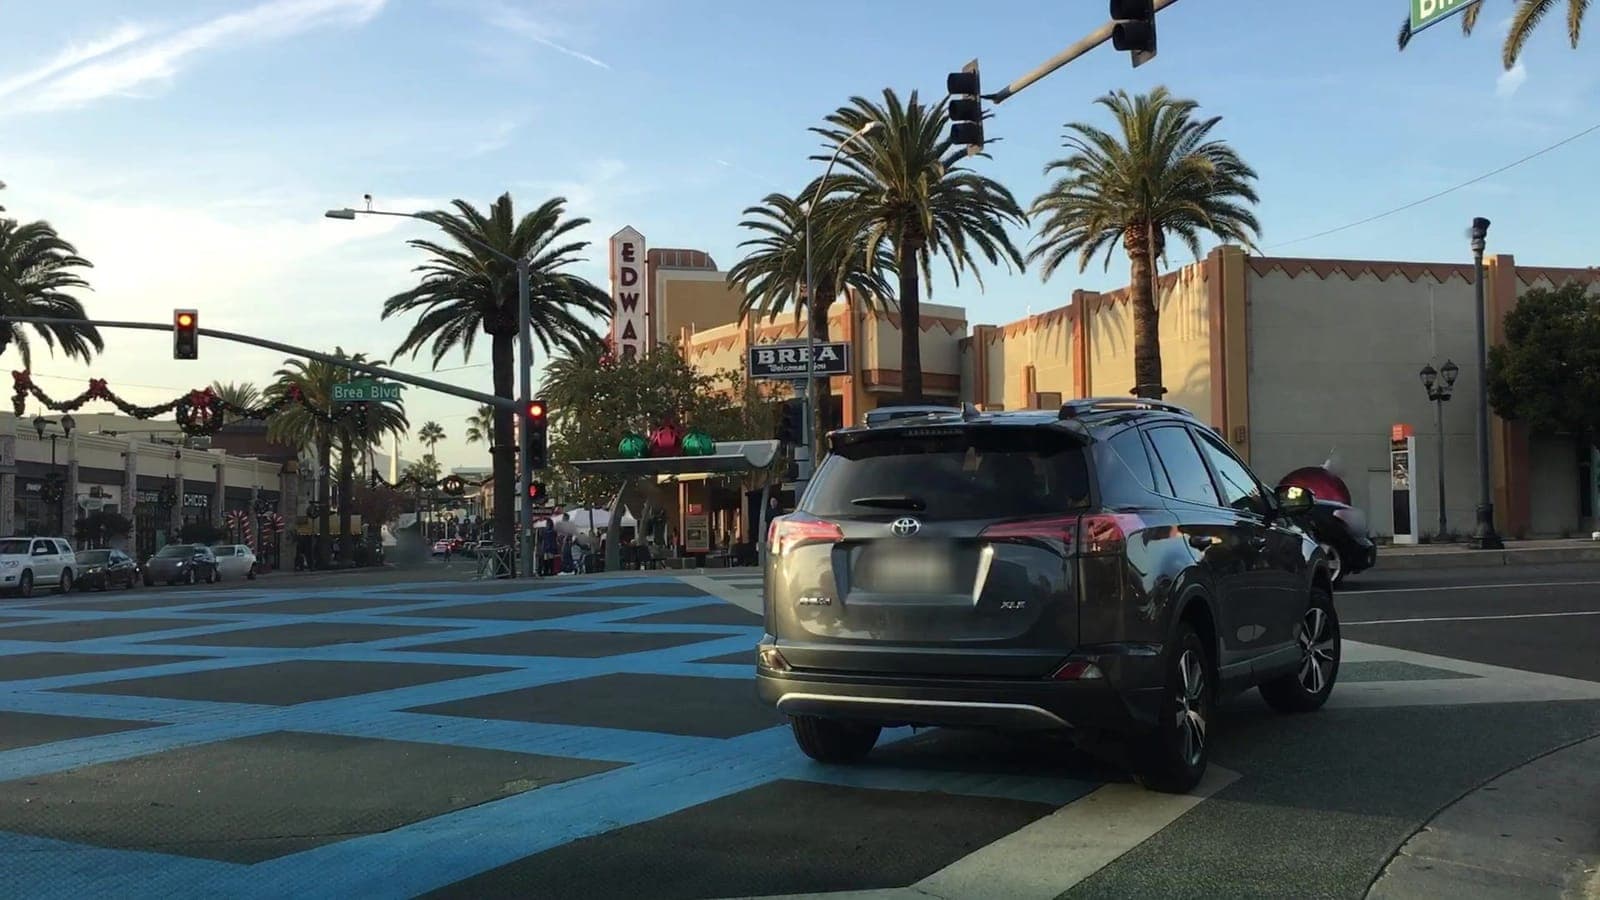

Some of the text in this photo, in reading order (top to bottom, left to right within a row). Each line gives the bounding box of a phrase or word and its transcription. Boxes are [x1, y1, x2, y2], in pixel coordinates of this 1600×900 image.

[757, 346, 839, 364] BREA
[334, 385, 398, 399] Brea Blvd
